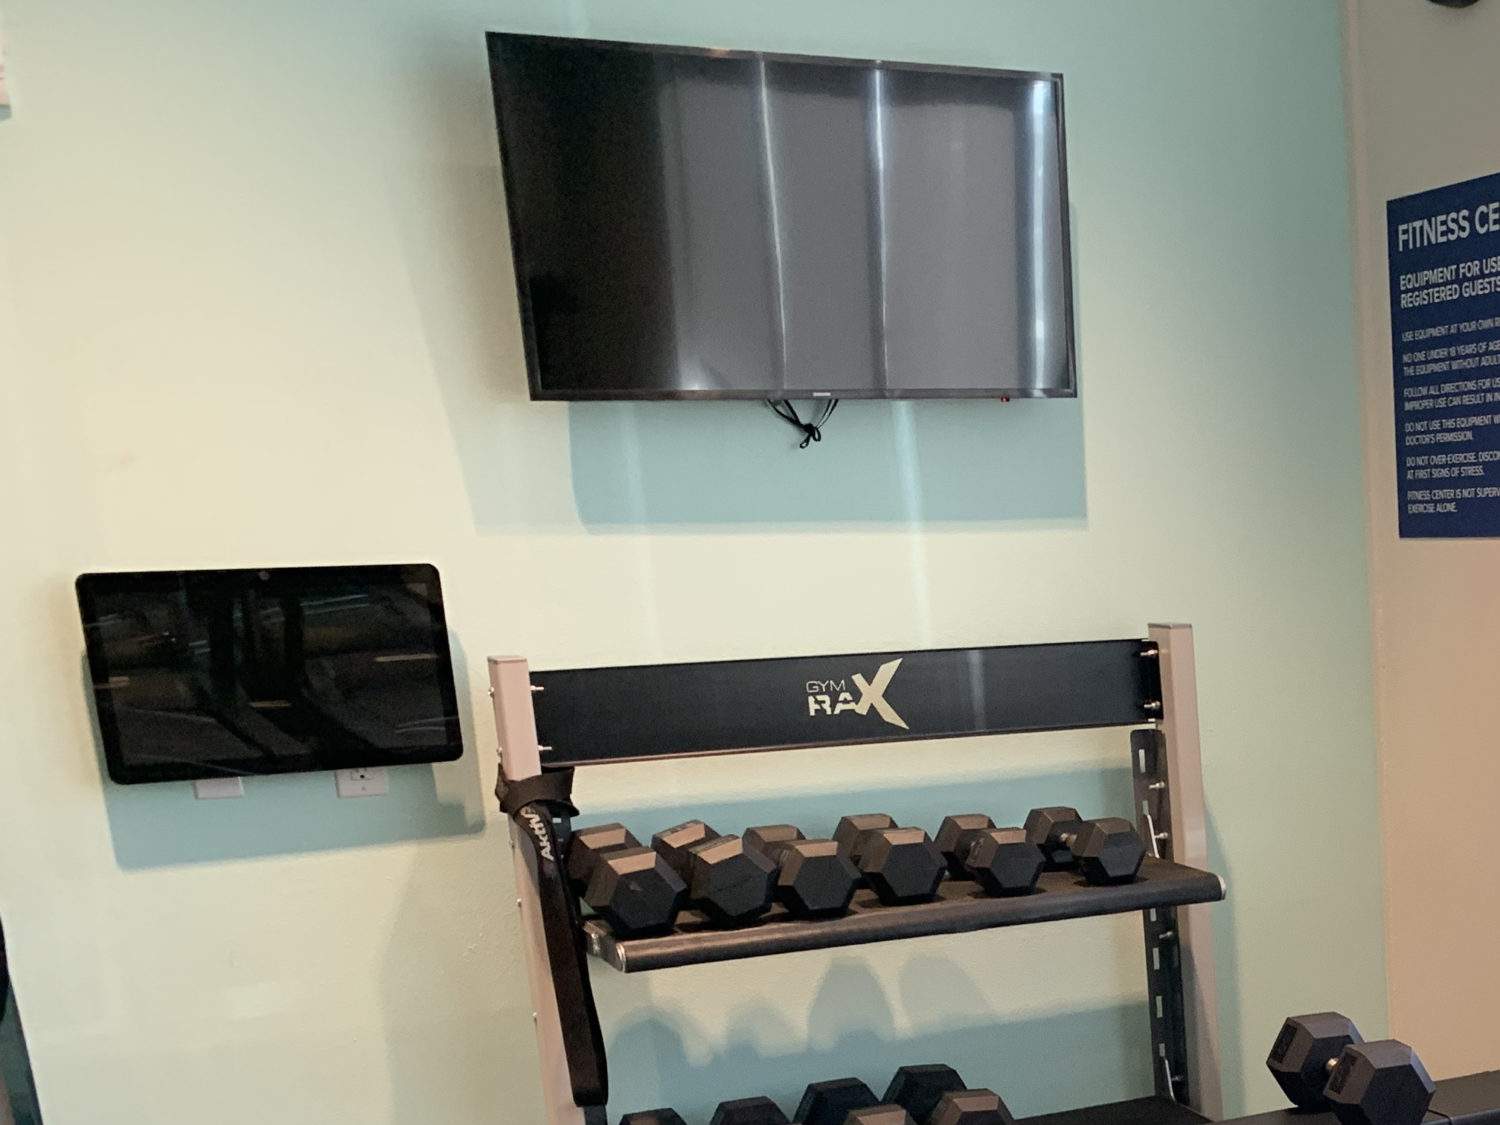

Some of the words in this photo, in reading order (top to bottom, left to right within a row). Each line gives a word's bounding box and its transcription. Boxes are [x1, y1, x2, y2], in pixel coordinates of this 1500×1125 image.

[1397, 209, 1469, 250] FITNESS
[1399, 265, 1456, 289] EQUIPMENT
[1459, 260, 1480, 278] FOR
[1400, 283, 1459, 308] REGISTERED
[805, 679, 846, 693] GYM
